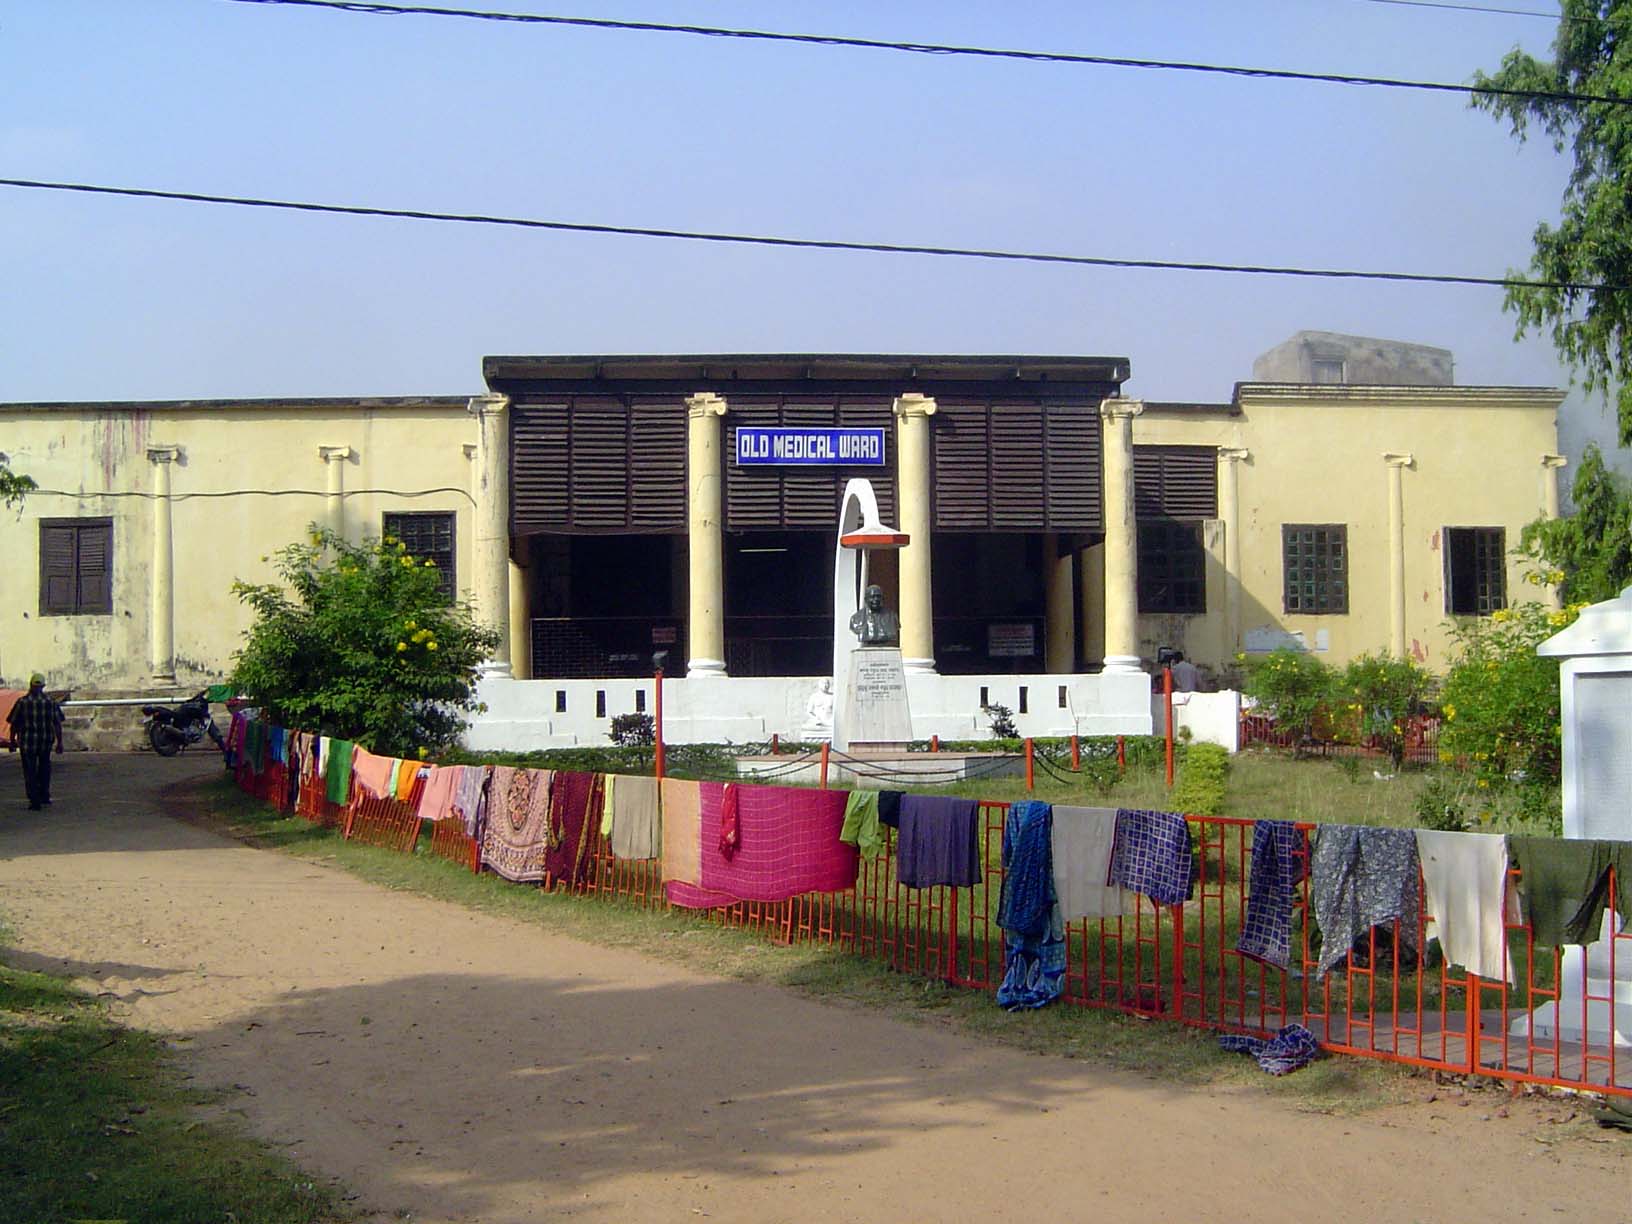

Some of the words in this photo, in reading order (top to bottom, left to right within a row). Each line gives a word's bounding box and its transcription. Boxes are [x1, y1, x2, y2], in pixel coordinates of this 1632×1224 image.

[741, 434, 769, 458] OLD
[773, 435, 835, 458] MEDICAL
[839, 435, 879, 458] WARD
